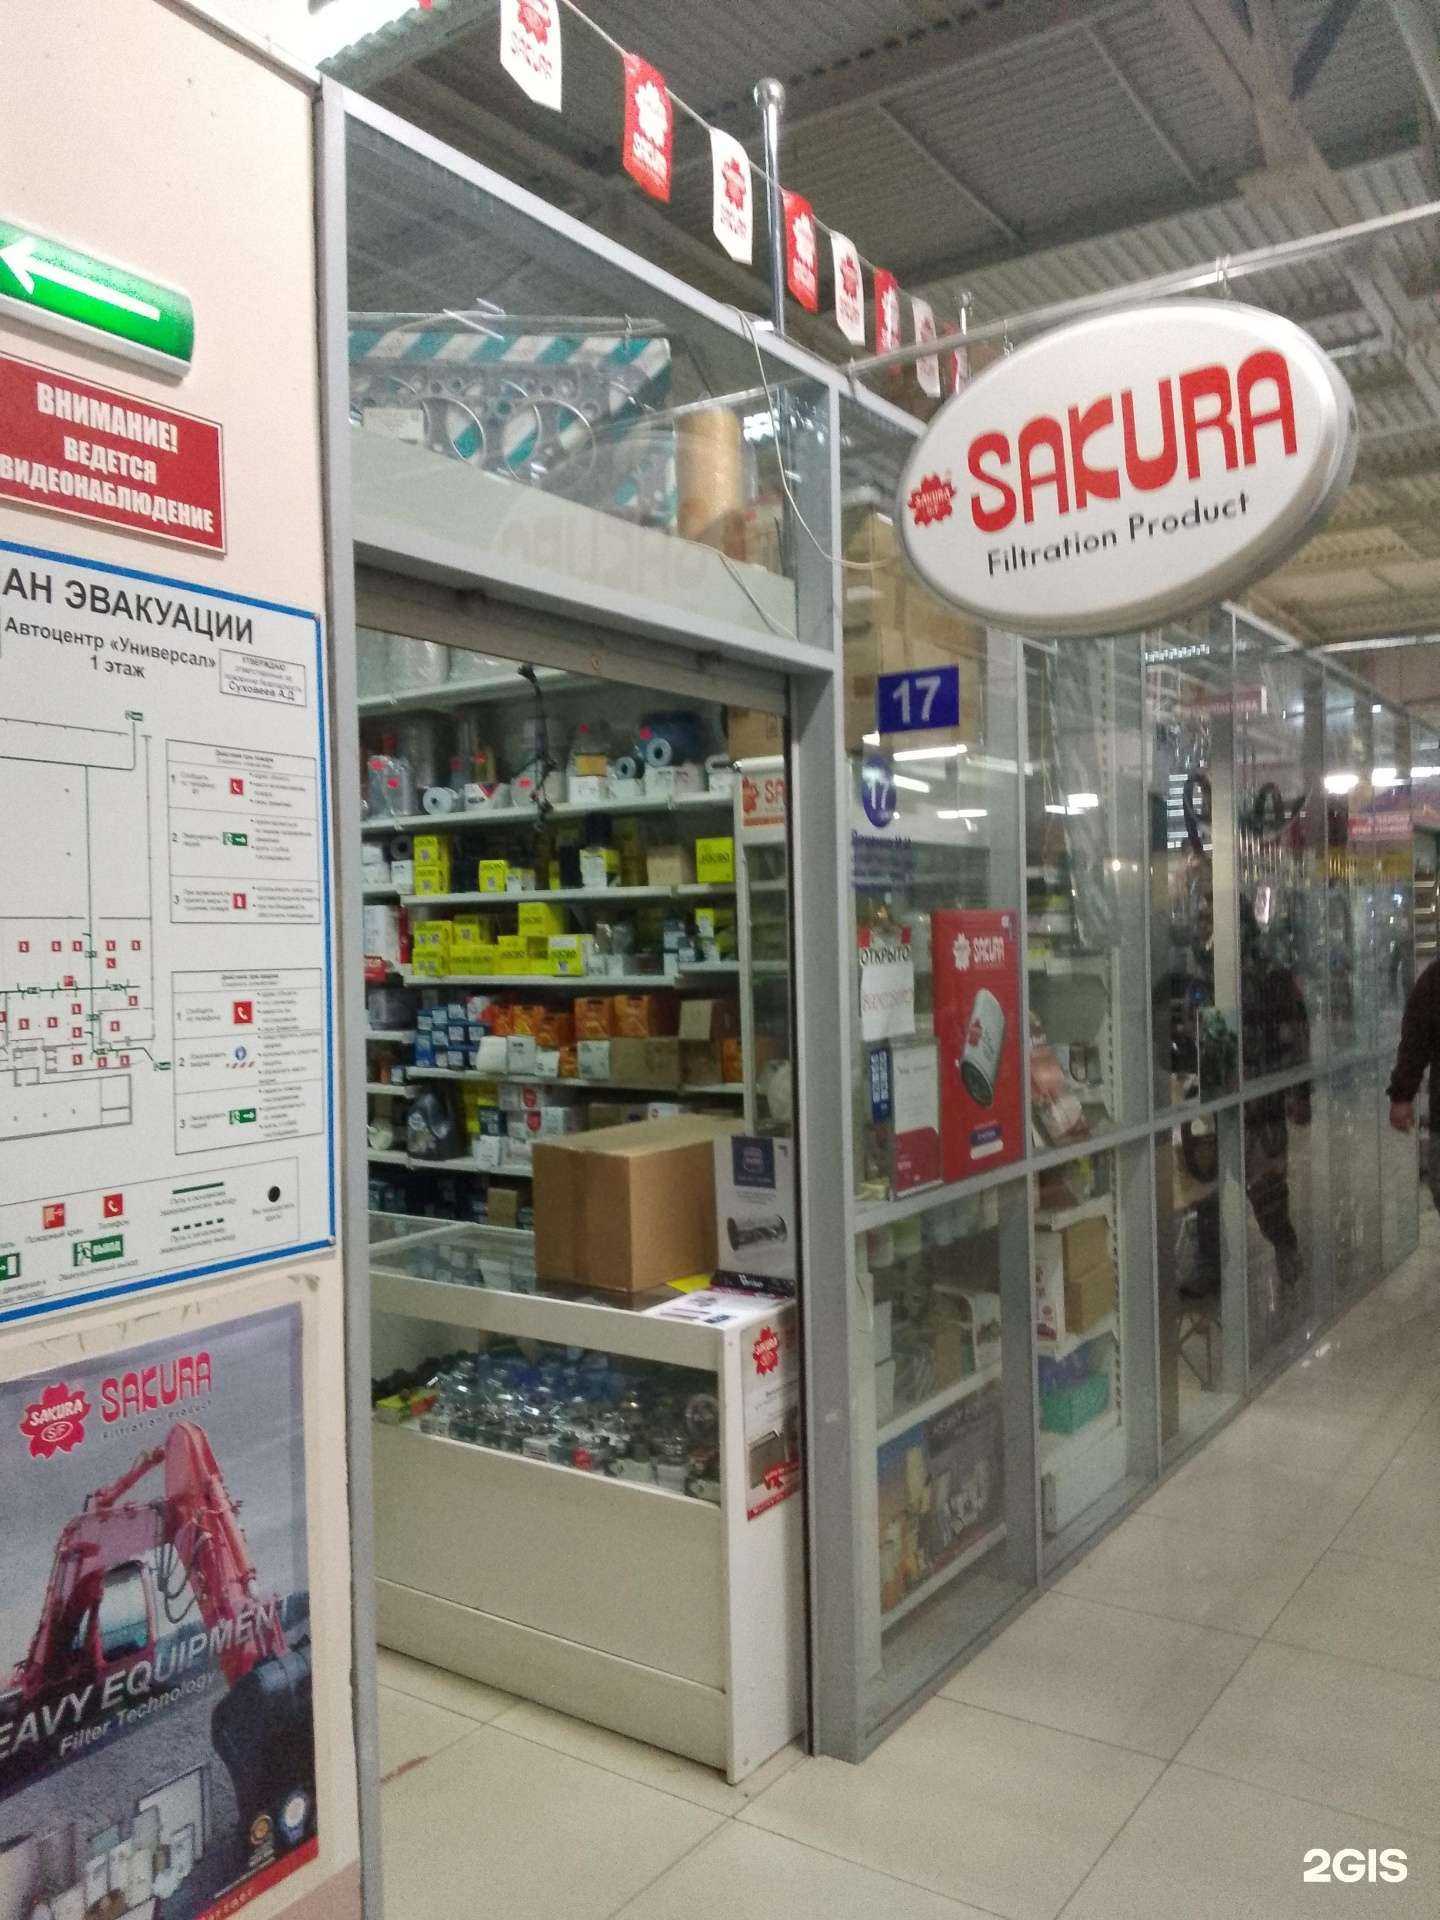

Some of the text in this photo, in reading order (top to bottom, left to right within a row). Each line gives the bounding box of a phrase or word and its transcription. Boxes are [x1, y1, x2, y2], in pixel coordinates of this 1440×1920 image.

[37, 381, 178, 454] ВНИМАНИЕ!
[967, 348, 1297, 533] SAKURA
[63, 435, 157, 485] ВЕДЕТСЯ
[0, 453, 214, 533] ВИДЕОНАБЛЮДЕНИЕ
[987, 491, 1249, 577] Filtration Product
[64, 579, 253, 644] ЭВАКУАЦИИ
[4, 616, 217, 669] Автоцентр «Универсал»
[90, 654, 147, 679] 1 этаж
[892, 675, 941, 724] 17
[29, 1398, 84, 1427] SAKURA
[102, 1352, 211, 1422] SAKURA
[60, 1719, 112, 1757] Filter
